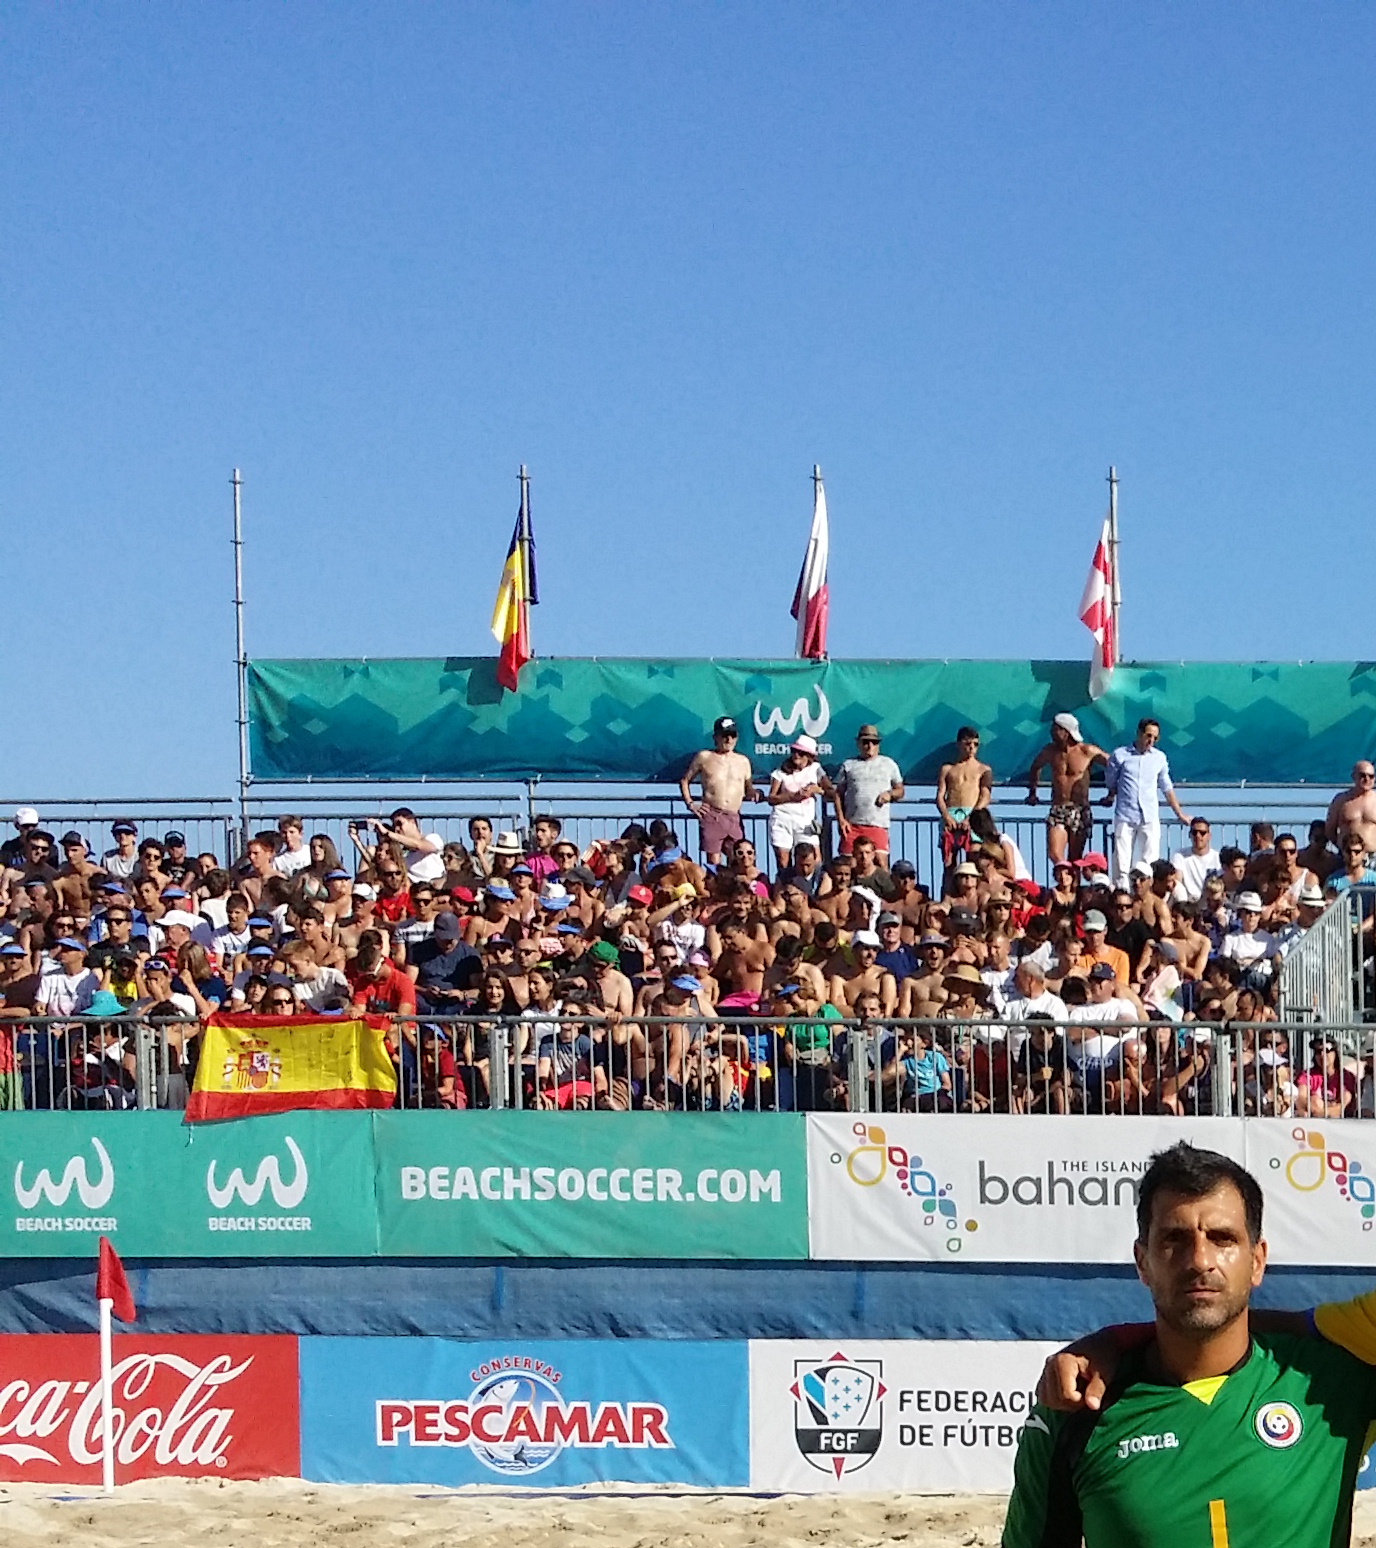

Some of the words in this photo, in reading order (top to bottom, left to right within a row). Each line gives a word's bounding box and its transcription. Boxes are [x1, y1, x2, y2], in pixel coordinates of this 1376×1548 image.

[755, 743, 790, 755] BEACH
[1062, 1161, 1091, 1172] THE
[402, 1166, 782, 1203] BEACHSOCCER.COM
[16, 1217, 62, 1231] BEACH
[64, 1217, 117, 1231] SOCCER
[208, 1217, 256, 1231] BEACH
[258, 1217, 312, 1231] SOCCER
[470, 1356, 562, 1383] CONSERVAS
[379, 1402, 671, 1445] PESCAMAR
[899, 1424, 934, 1447] DE
[943, 1418, 1021, 1447] FÚTB
[820, 1432, 860, 1451] FGF
